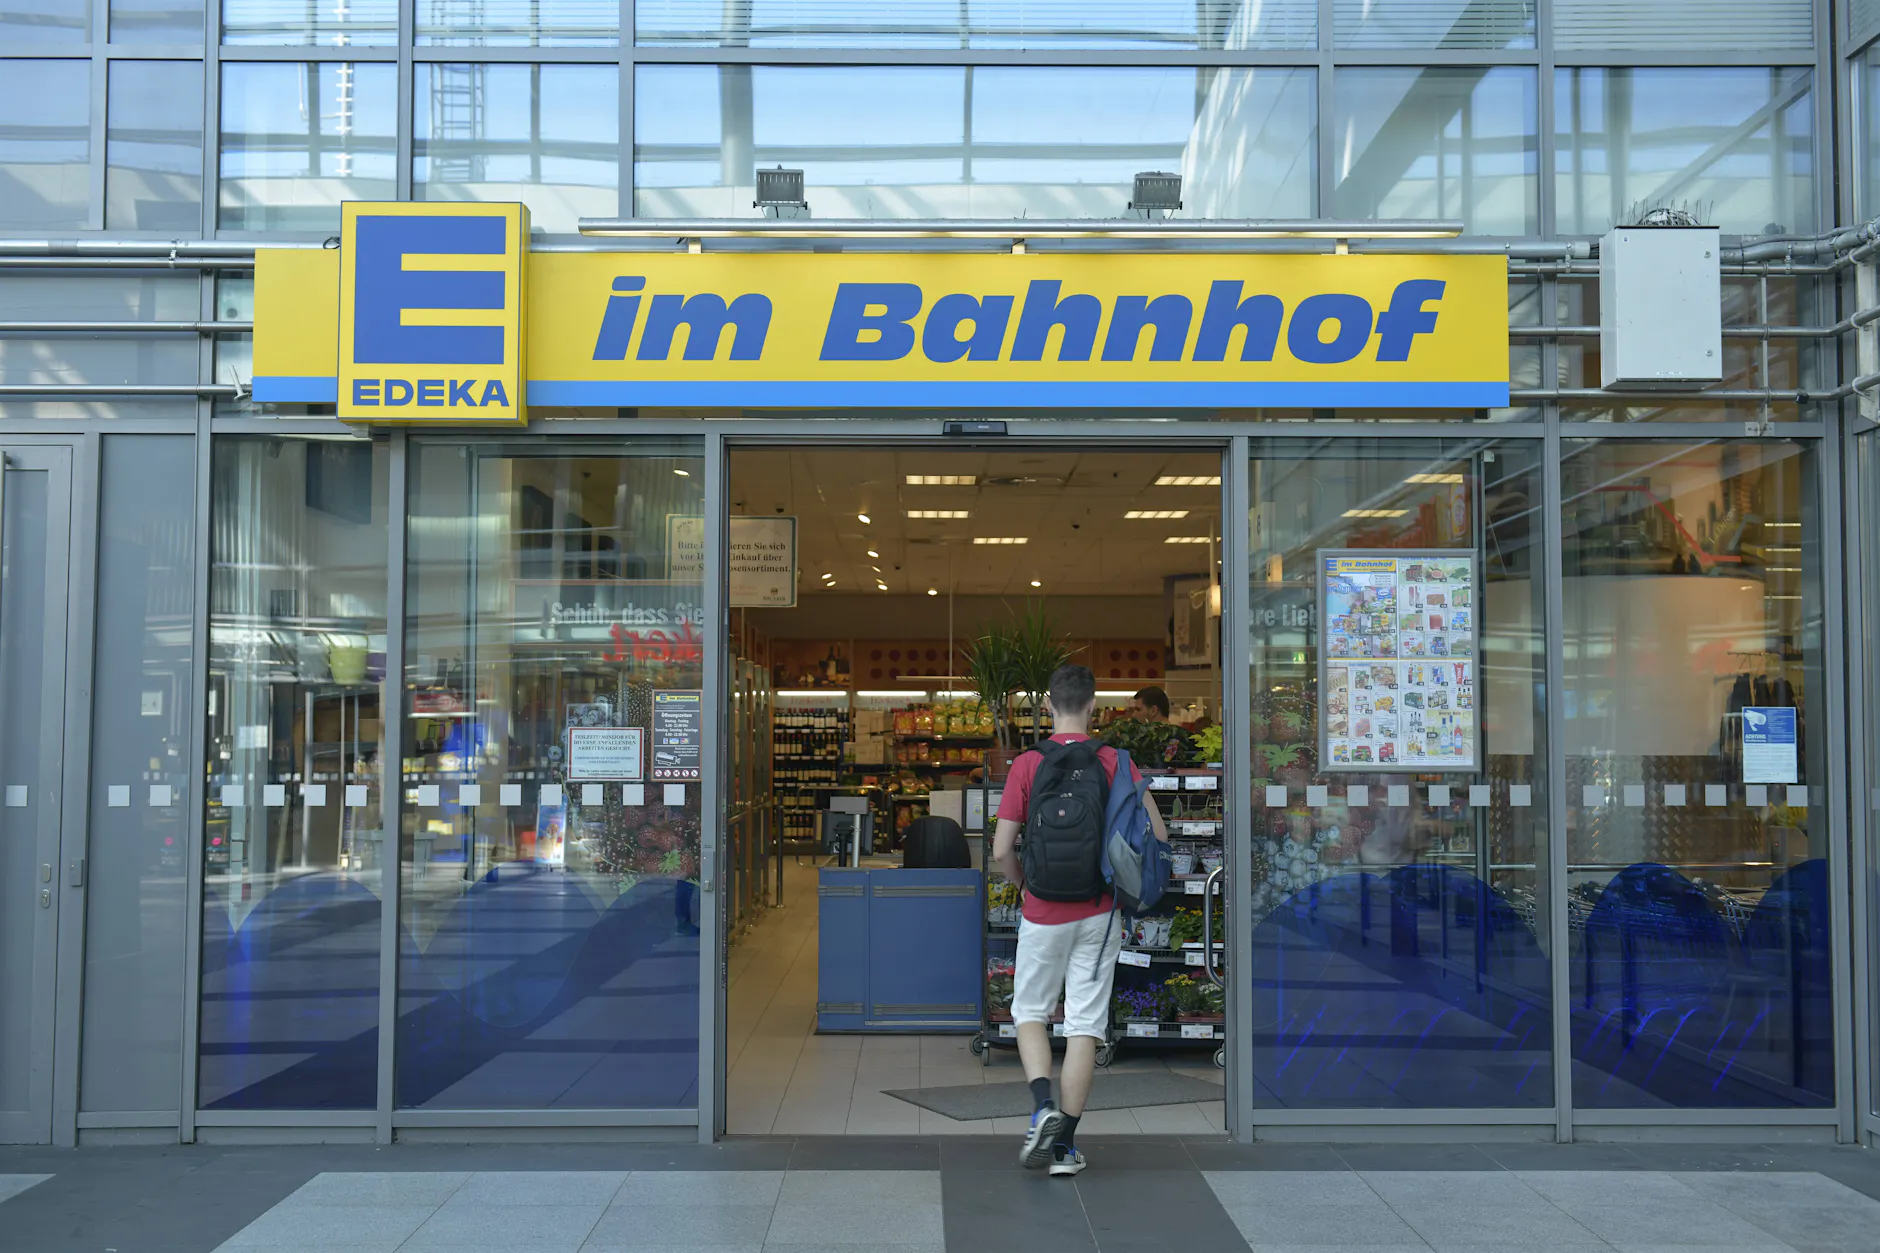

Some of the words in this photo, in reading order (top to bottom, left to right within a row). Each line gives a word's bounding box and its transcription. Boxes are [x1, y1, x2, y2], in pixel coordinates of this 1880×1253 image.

[353, 215, 506, 364] E
[592, 276, 773, 360] im
[819, 279, 1446, 364] Bahnhof
[352, 379, 510, 407] EDEKA
[678, 541, 699, 550] Bitte
[754, 541, 766, 550] Sie
[769, 541, 785, 550] sich
[763, 552, 783, 561] über
[622, 602, 669, 625] dass
[675, 602, 703, 625] Sie
